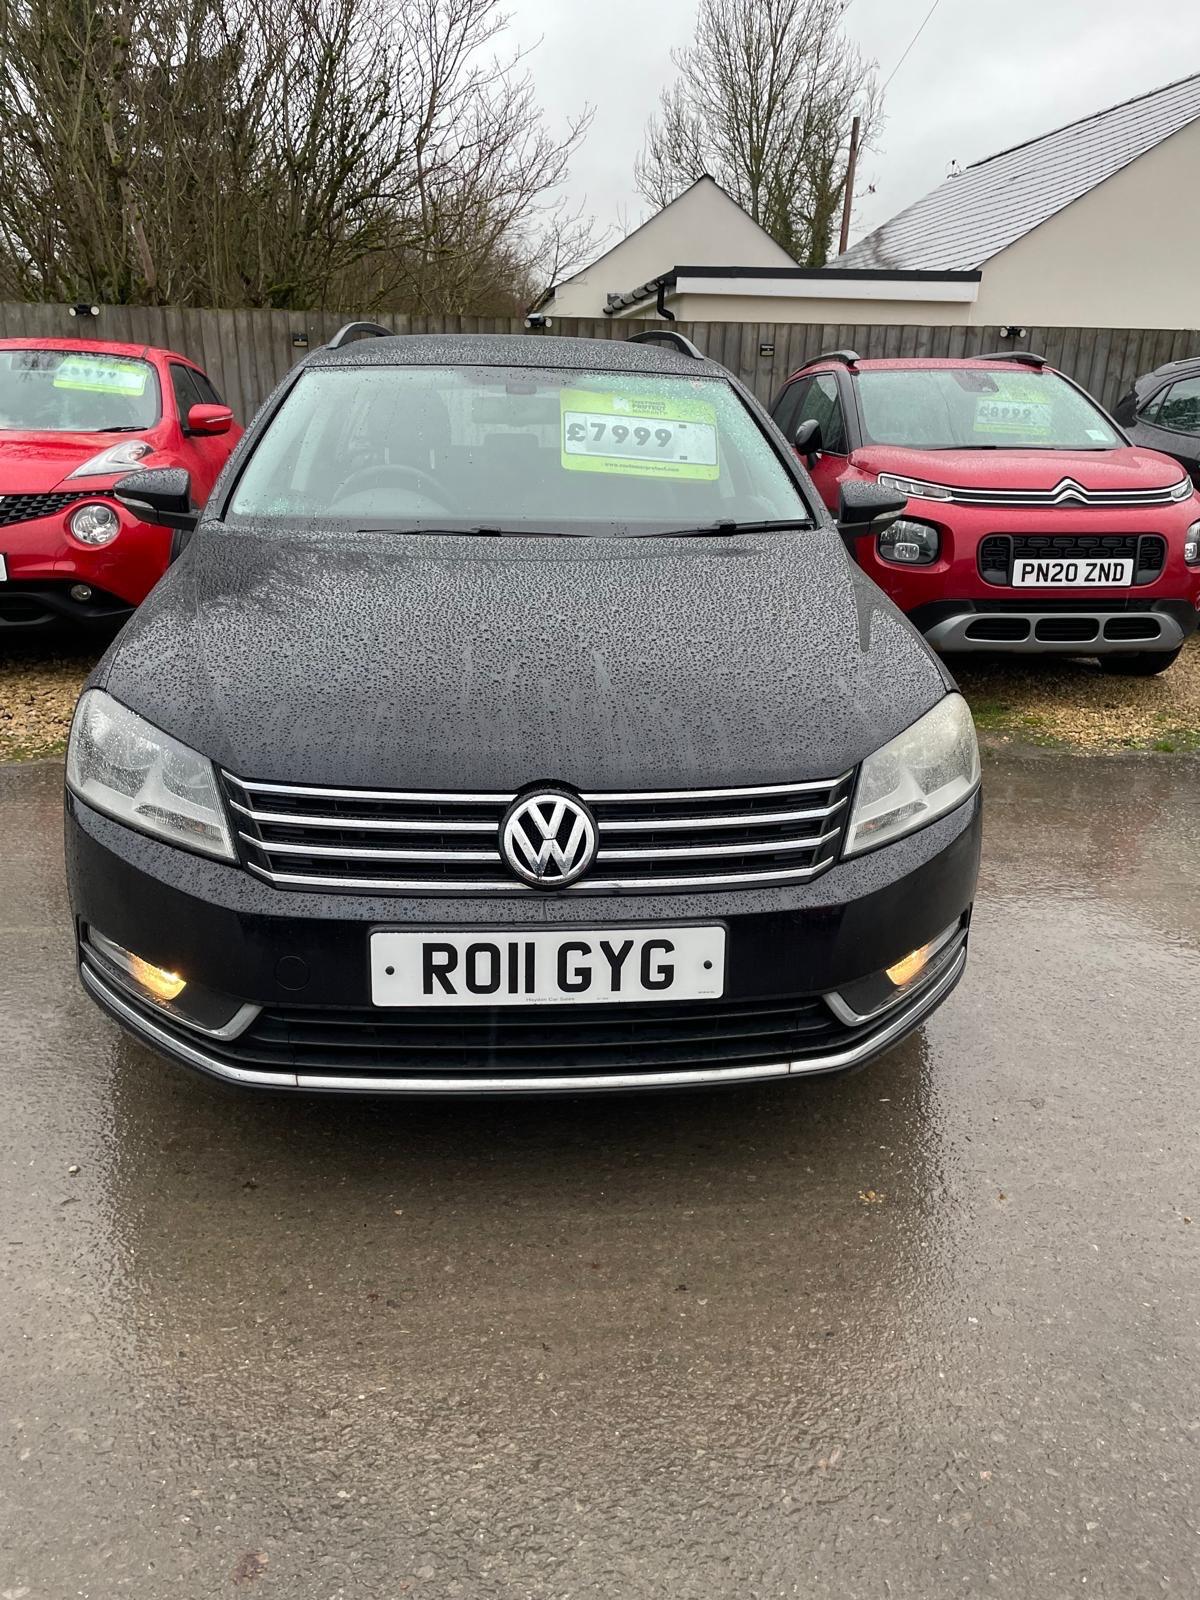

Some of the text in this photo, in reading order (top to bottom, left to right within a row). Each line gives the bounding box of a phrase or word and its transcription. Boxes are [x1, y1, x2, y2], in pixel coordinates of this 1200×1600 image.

[567, 423, 672, 447] £7999
[1021, 563, 1124, 582] PN20 ZND
[422, 939, 675, 995] RO11 GYG
